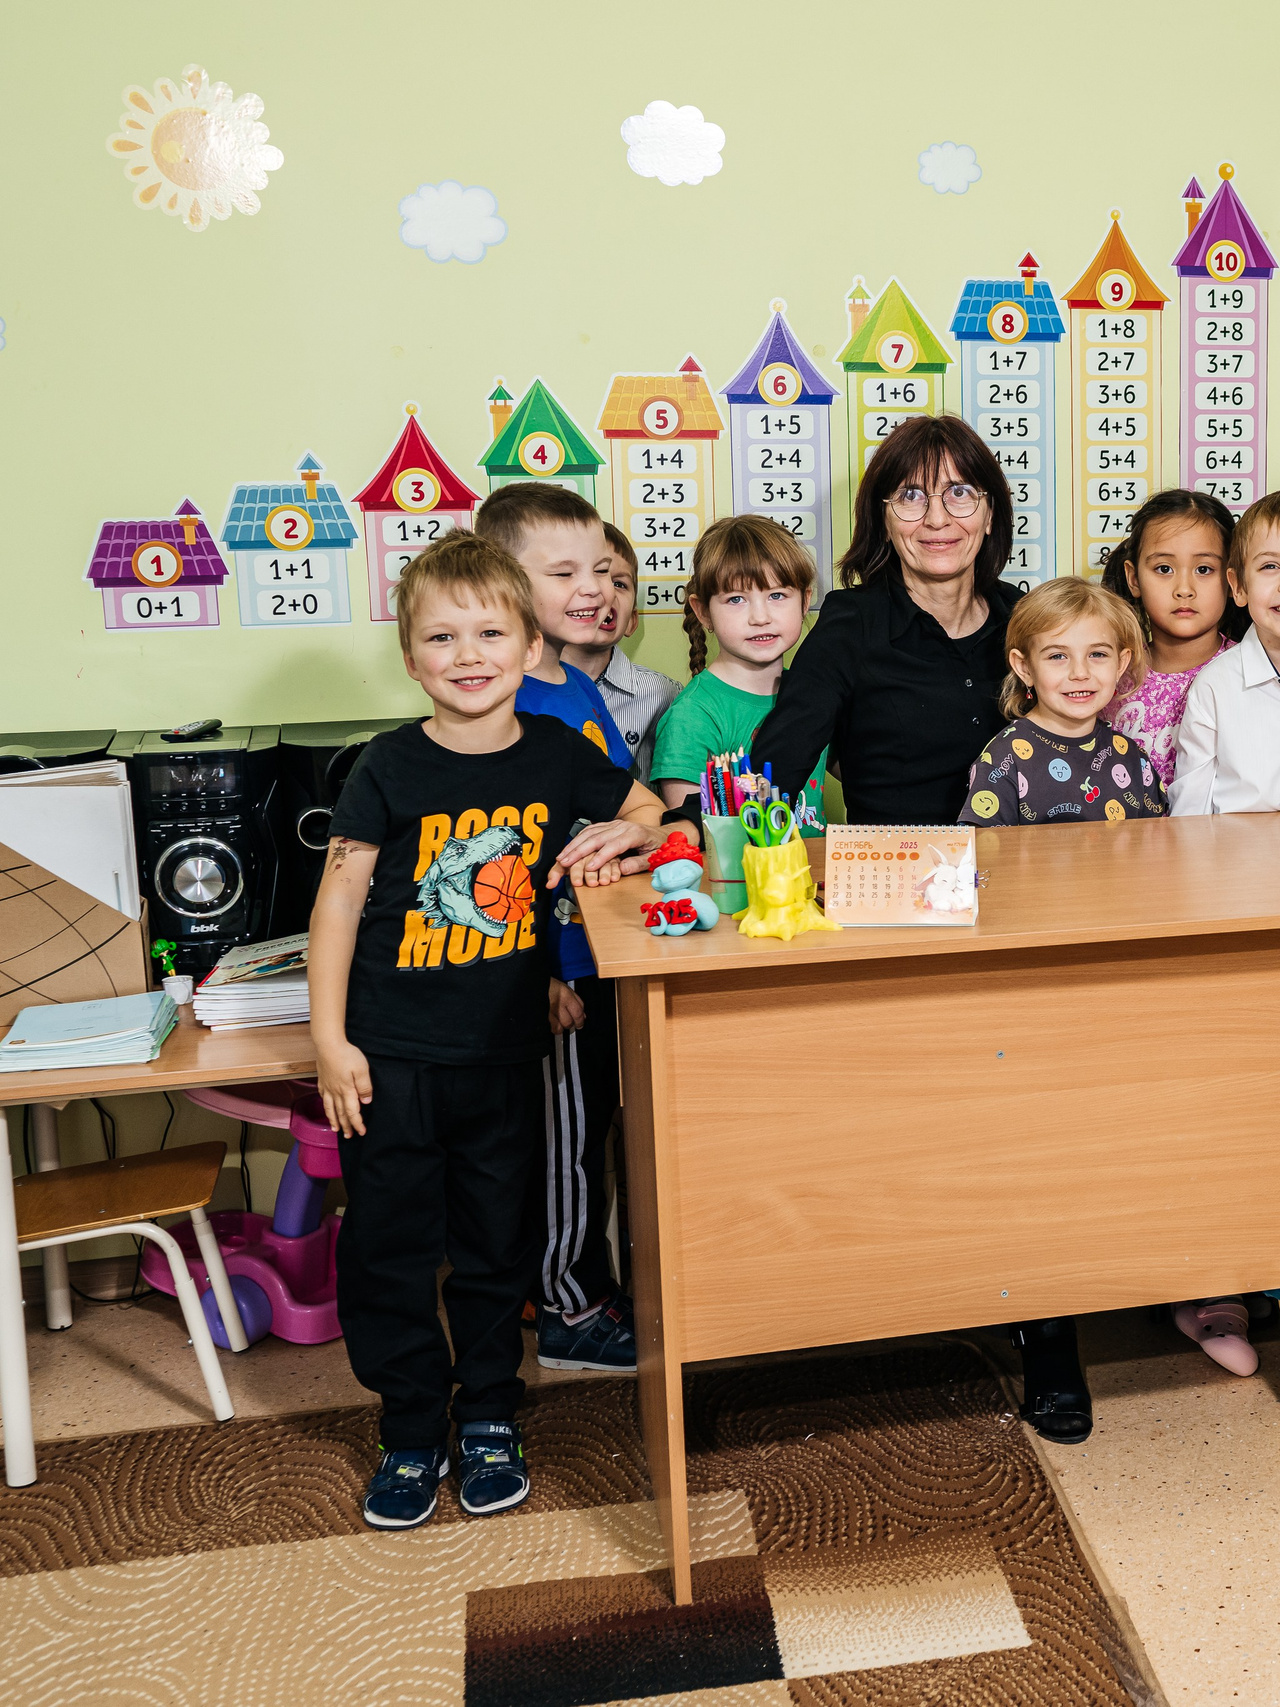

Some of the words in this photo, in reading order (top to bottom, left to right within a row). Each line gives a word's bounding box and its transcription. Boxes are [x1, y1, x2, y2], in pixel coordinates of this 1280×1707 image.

[1214, 252, 1237, 271] 10
[1111, 282, 1123, 301] 9
[1207, 289, 1244, 309] 1+9
[1001, 314, 1015, 334] 8
[1097, 319, 1136, 339] 1+8
[1206, 322, 1244, 342] 2+8
[891, 343, 904, 363] 7
[989, 351, 1027, 371] 1+7
[1097, 352, 1135, 371] 2+7
[1207, 354, 1243, 373] 3+7
[773, 375, 787, 395] 6
[876, 382, 916, 402] 1+6
[989, 384, 1028, 404] 2+6
[1098, 384, 1136, 404] 3+6
[1206, 387, 1243, 406] 4+6
[655, 409, 668, 429] 5
[760, 415, 801, 434] 1+5
[990, 417, 1029, 437] 3+5
[1098, 417, 1136, 437] 4+5
[1206, 419, 1243, 438] 5+5
[532, 445, 548, 464] 4
[641, 449, 684, 469] 1+4
[760, 449, 802, 468] 2+4
[1098, 450, 1136, 469] 5+4
[1206, 451, 1243, 470] 6+4
[411, 481, 424, 502] 3
[642, 484, 685, 503] 2+3
[762, 482, 803, 502] 3+3
[1098, 482, 1136, 501] 6+3
[284, 518, 299, 539] 2
[397, 520, 440, 540] 1+2
[644, 518, 686, 538] 3+2
[150, 555, 164, 576] 1
[269, 559, 314, 580] 1+1
[645, 552, 685, 571] 4+1
[137, 597, 184, 618] 0+1
[271, 594, 318, 615] 2+0
[1047, 803, 1082, 818] SMILE
[834, 841, 873, 849] СЕНТЯБРЬ
[640, 898, 698, 927] 2025
[190, 924, 219, 933] bbk
